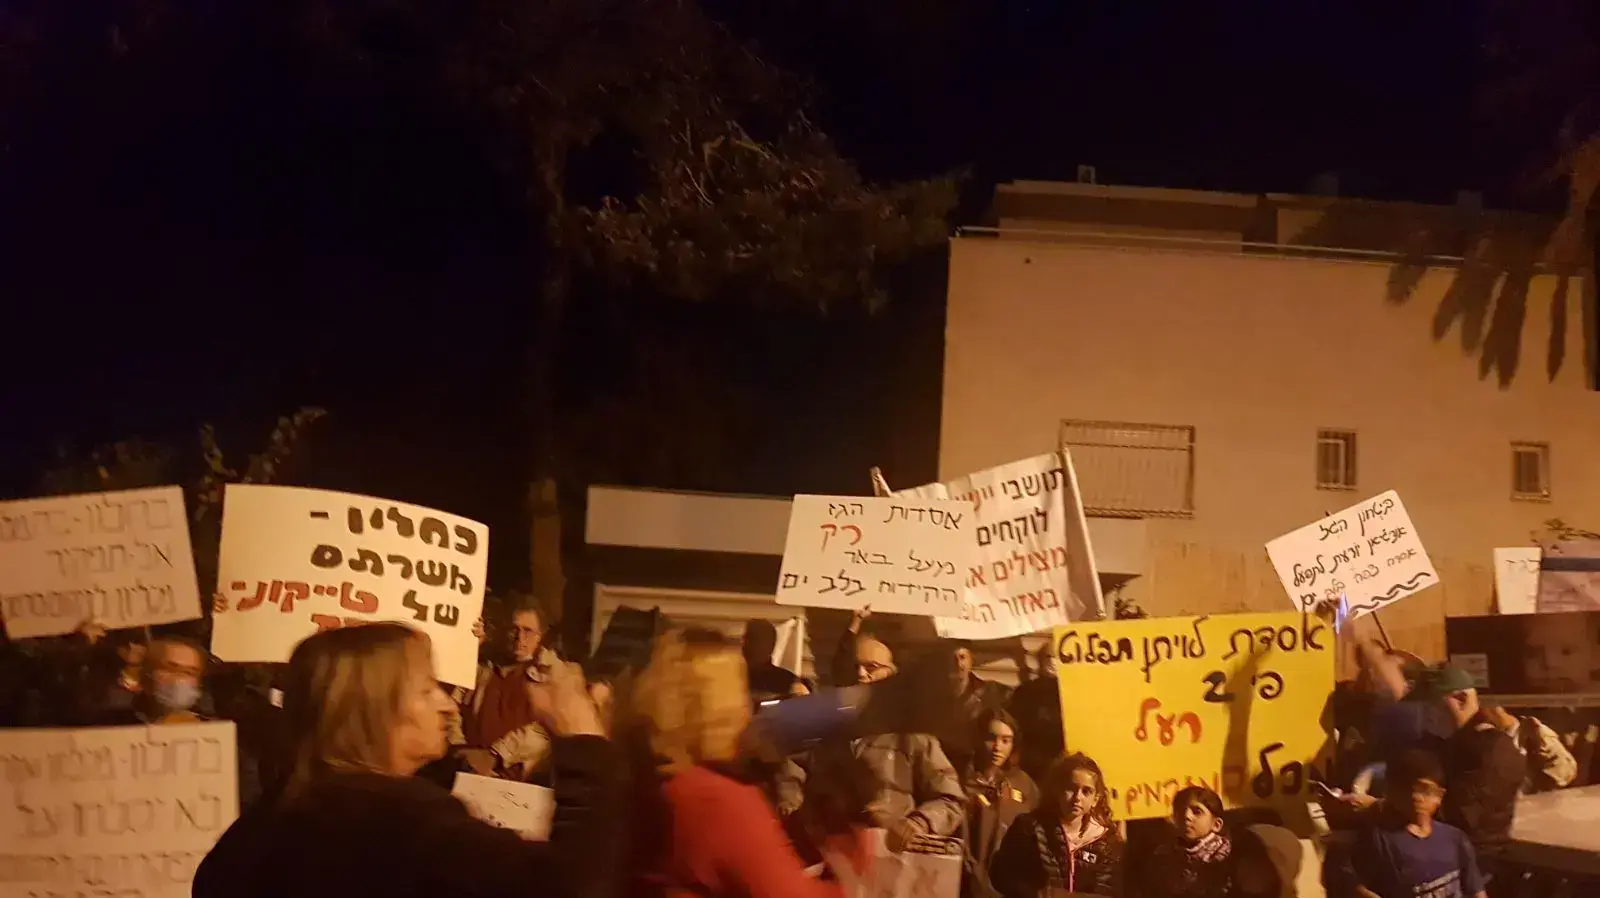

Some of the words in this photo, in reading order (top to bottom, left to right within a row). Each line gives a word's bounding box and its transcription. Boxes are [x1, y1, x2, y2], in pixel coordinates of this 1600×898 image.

[1000, 467, 1065, 500] תושבי
[828, 503, 864, 519] הגז
[883, 504, 963, 530] אסדות
[347, 506, 478, 555] כחלון
[820, 523, 862, 553] רק
[976, 507, 1048, 547] לוקחים
[844, 549, 894, 565] באר
[906, 549, 956, 577] מעל
[993, 547, 1068, 582] מצילים
[782, 573, 808, 589] ים
[817, 569, 867, 596] בלב
[878, 579, 958, 603] הקידוח
[402, 590, 460, 626] של
[999, 588, 1060, 617] באזור
